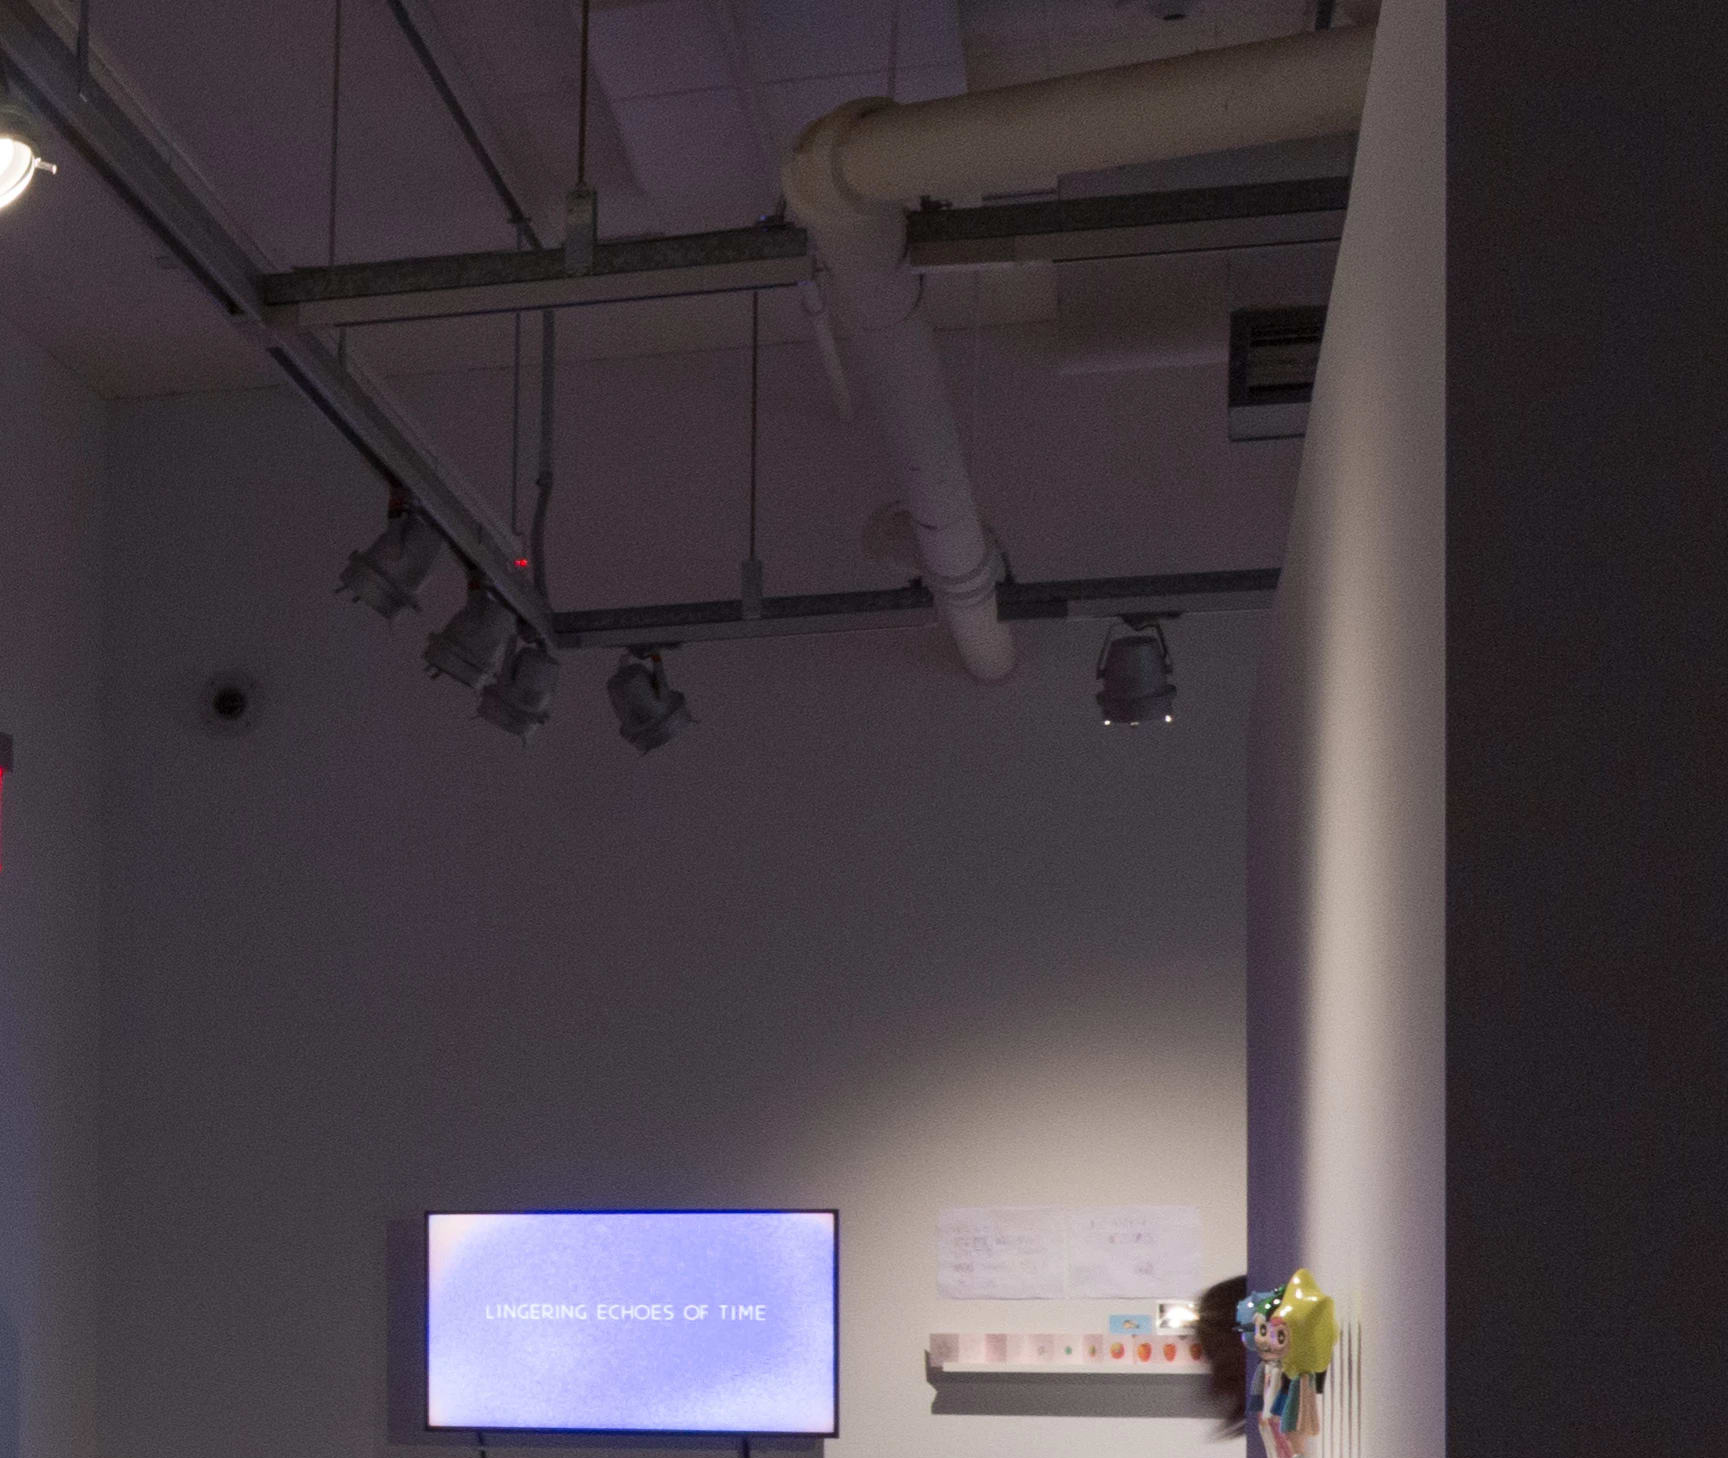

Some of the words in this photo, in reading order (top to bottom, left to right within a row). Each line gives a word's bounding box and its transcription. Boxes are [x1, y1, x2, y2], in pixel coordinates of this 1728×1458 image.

[485, 1303, 588, 1321] LINGERING
[597, 1304, 675, 1321] ECHOES
[683, 1304, 710, 1321] OF
[719, 1304, 767, 1321] TIME
